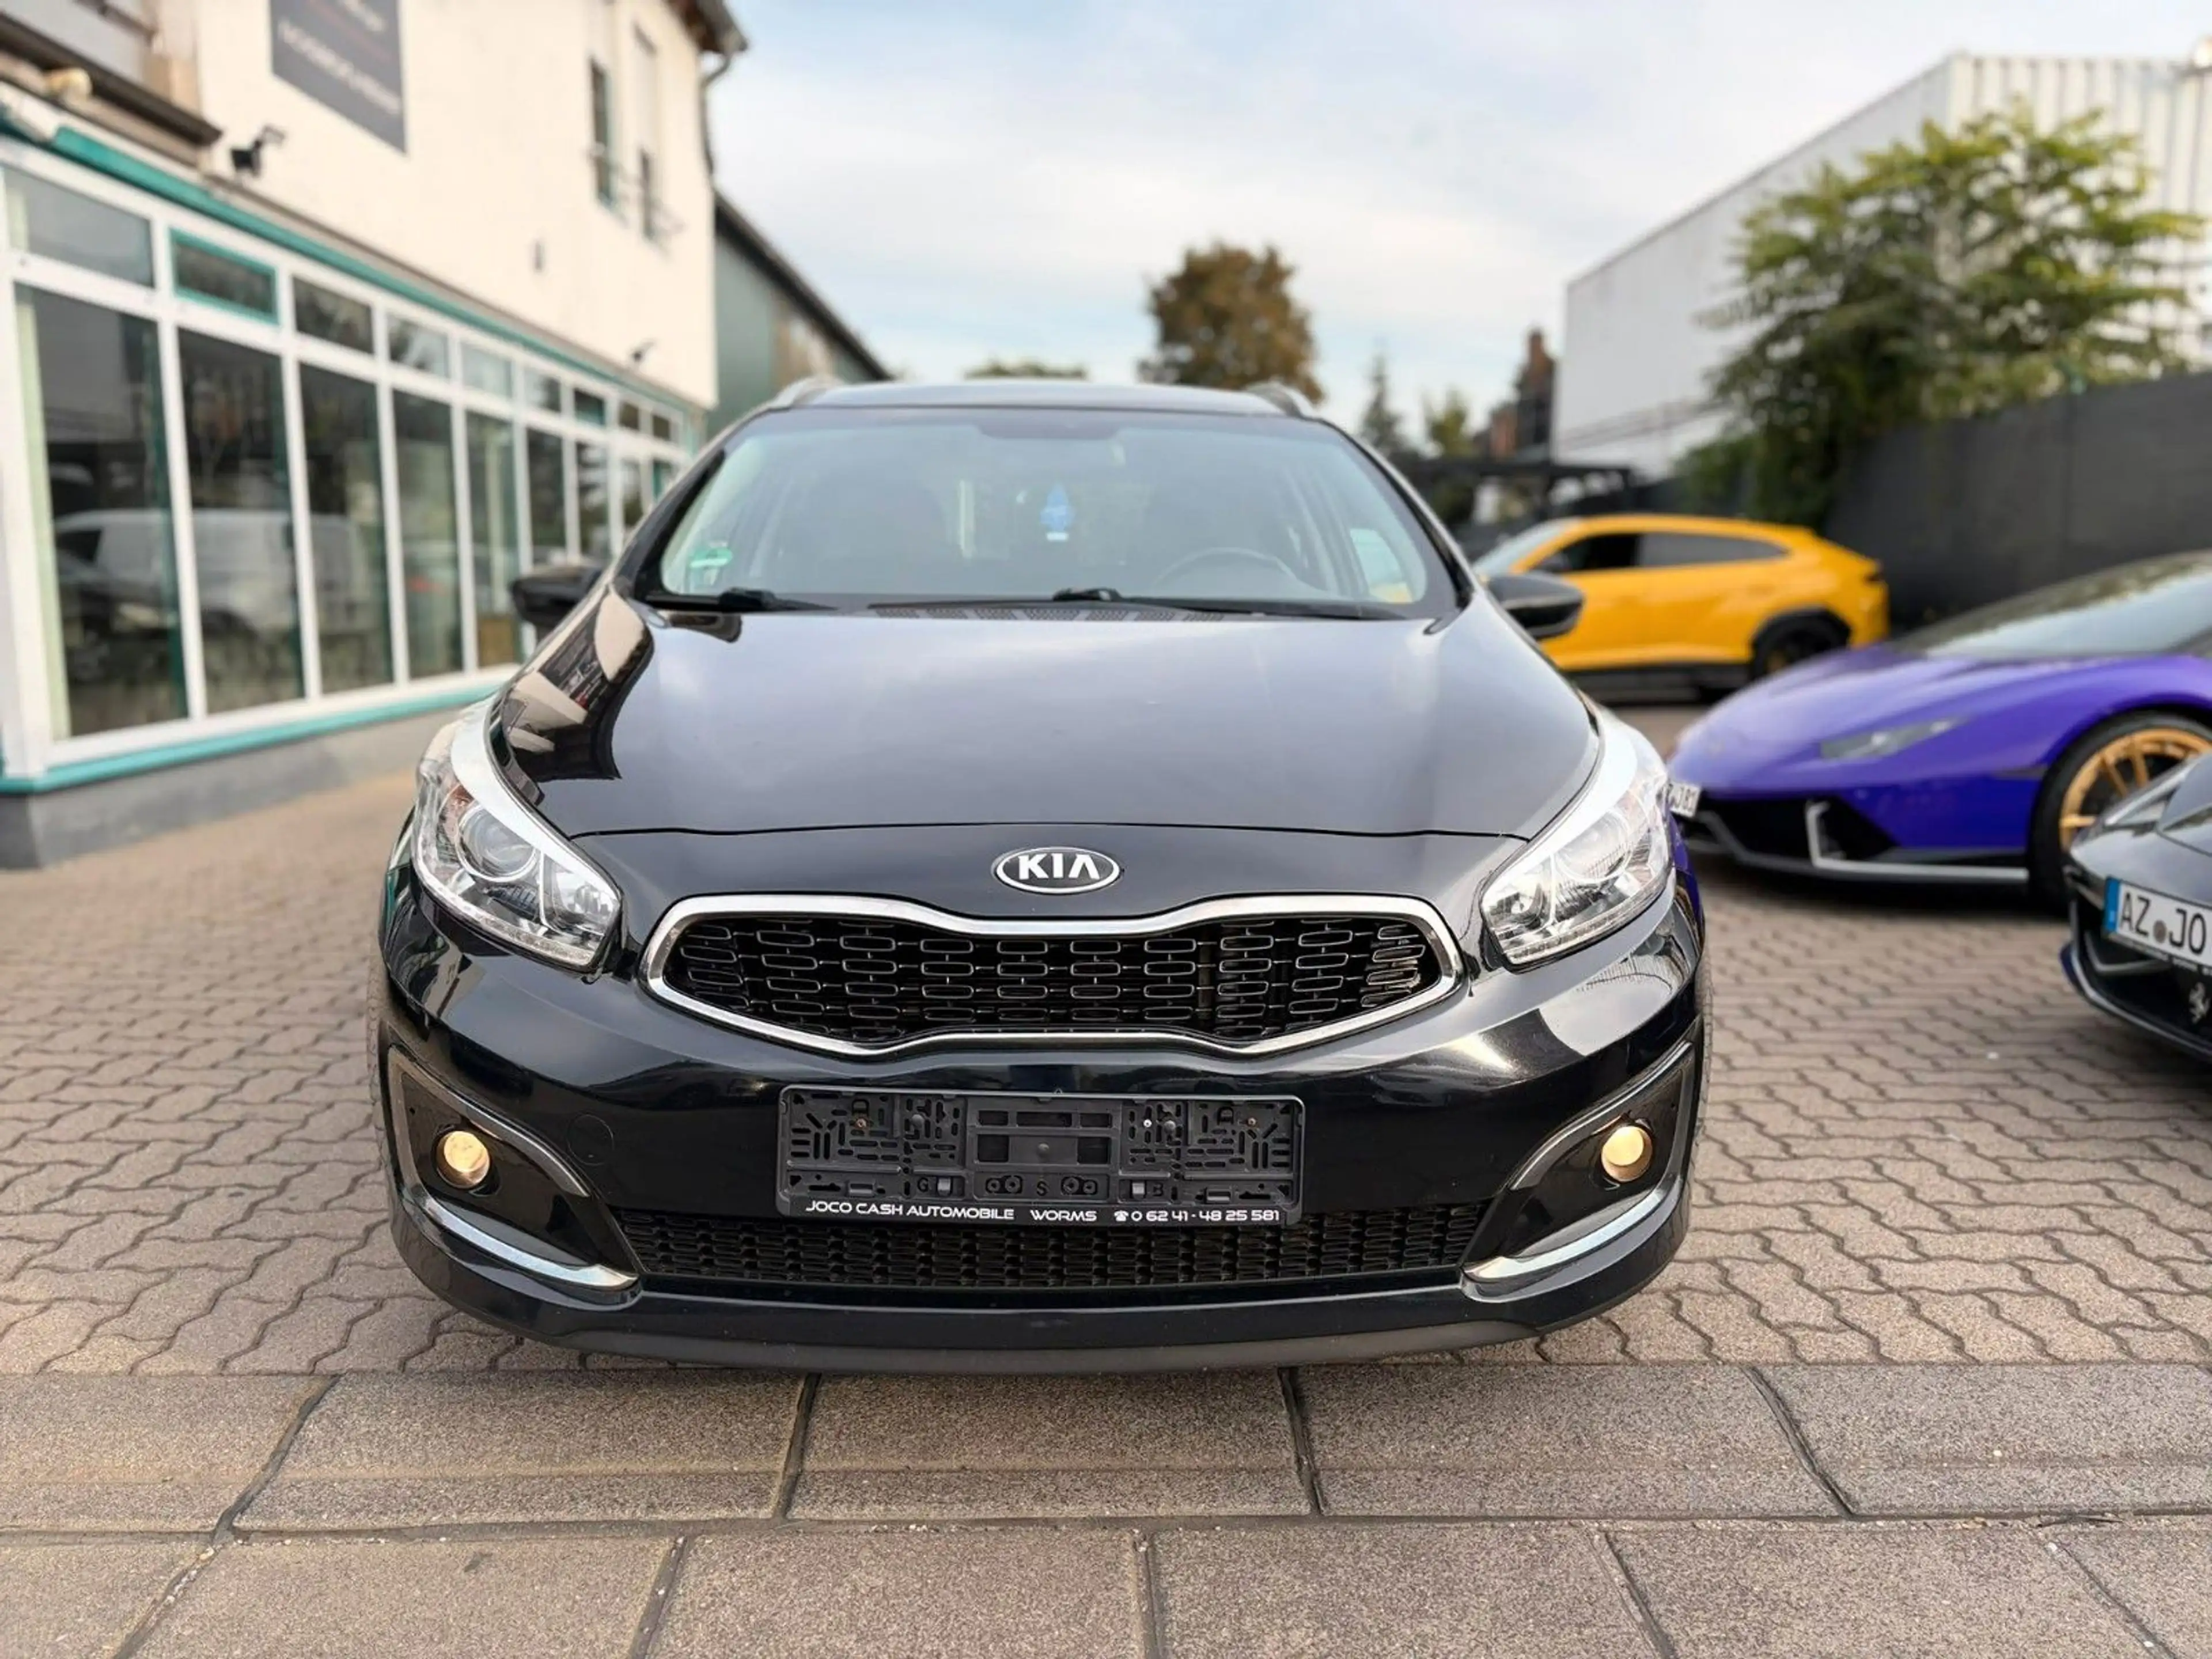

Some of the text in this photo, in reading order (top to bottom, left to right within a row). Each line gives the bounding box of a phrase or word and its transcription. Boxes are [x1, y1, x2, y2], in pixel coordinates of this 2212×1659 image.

[1017, 853, 1100, 880] KIA
[2120, 891, 2206, 955] AZ JO
[805, 1200, 853, 1213] JOCO
[855, 1203, 903, 1216] CASH
[906, 1205, 1014, 1220] AUTOMOBILE
[1030, 1209, 1097, 1222] WORMS
[1146, 1210, 1169, 1222] 62
[1225, 1210, 1248, 1221] 25
[1251, 1209, 1280, 1221] 581
